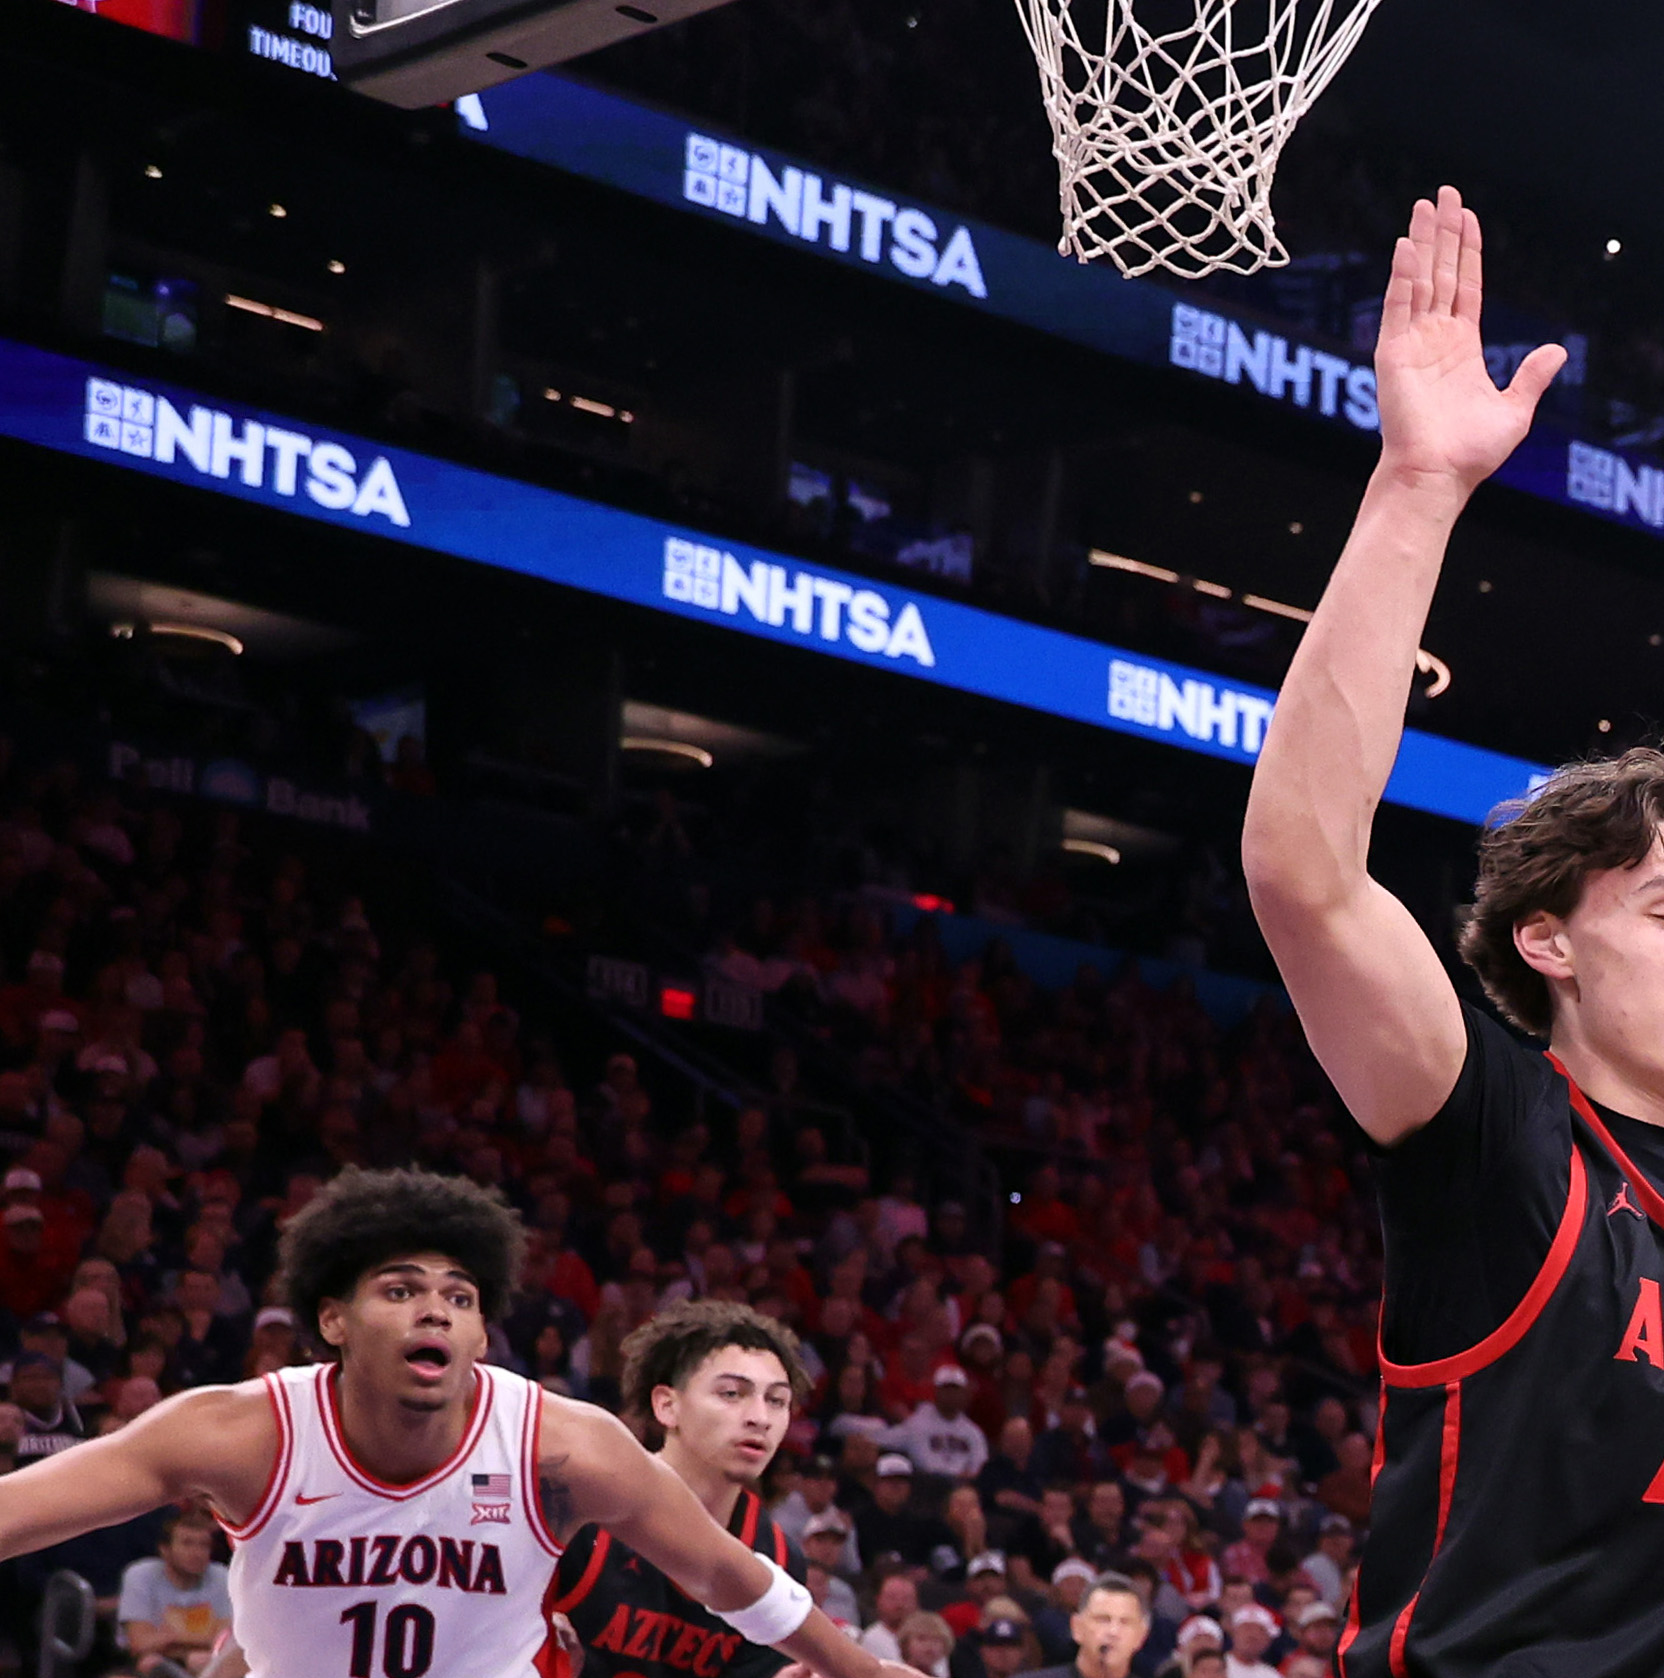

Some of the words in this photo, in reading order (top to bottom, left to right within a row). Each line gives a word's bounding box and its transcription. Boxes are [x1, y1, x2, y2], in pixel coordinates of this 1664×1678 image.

[249, 25, 338, 81] TIMEOU
[290, 0, 332, 39] FOU
[747, 154, 987, 298] NHTSA
[1226, 317, 1382, 432] NHTS
[157, 397, 410, 527] NHTSA
[720, 552, 935, 667] NHTSA
[1156, 672, 1277, 754] NHT
[273, 1535, 507, 1596] ARIZONA
[591, 1603, 742, 1678] AZTECS
